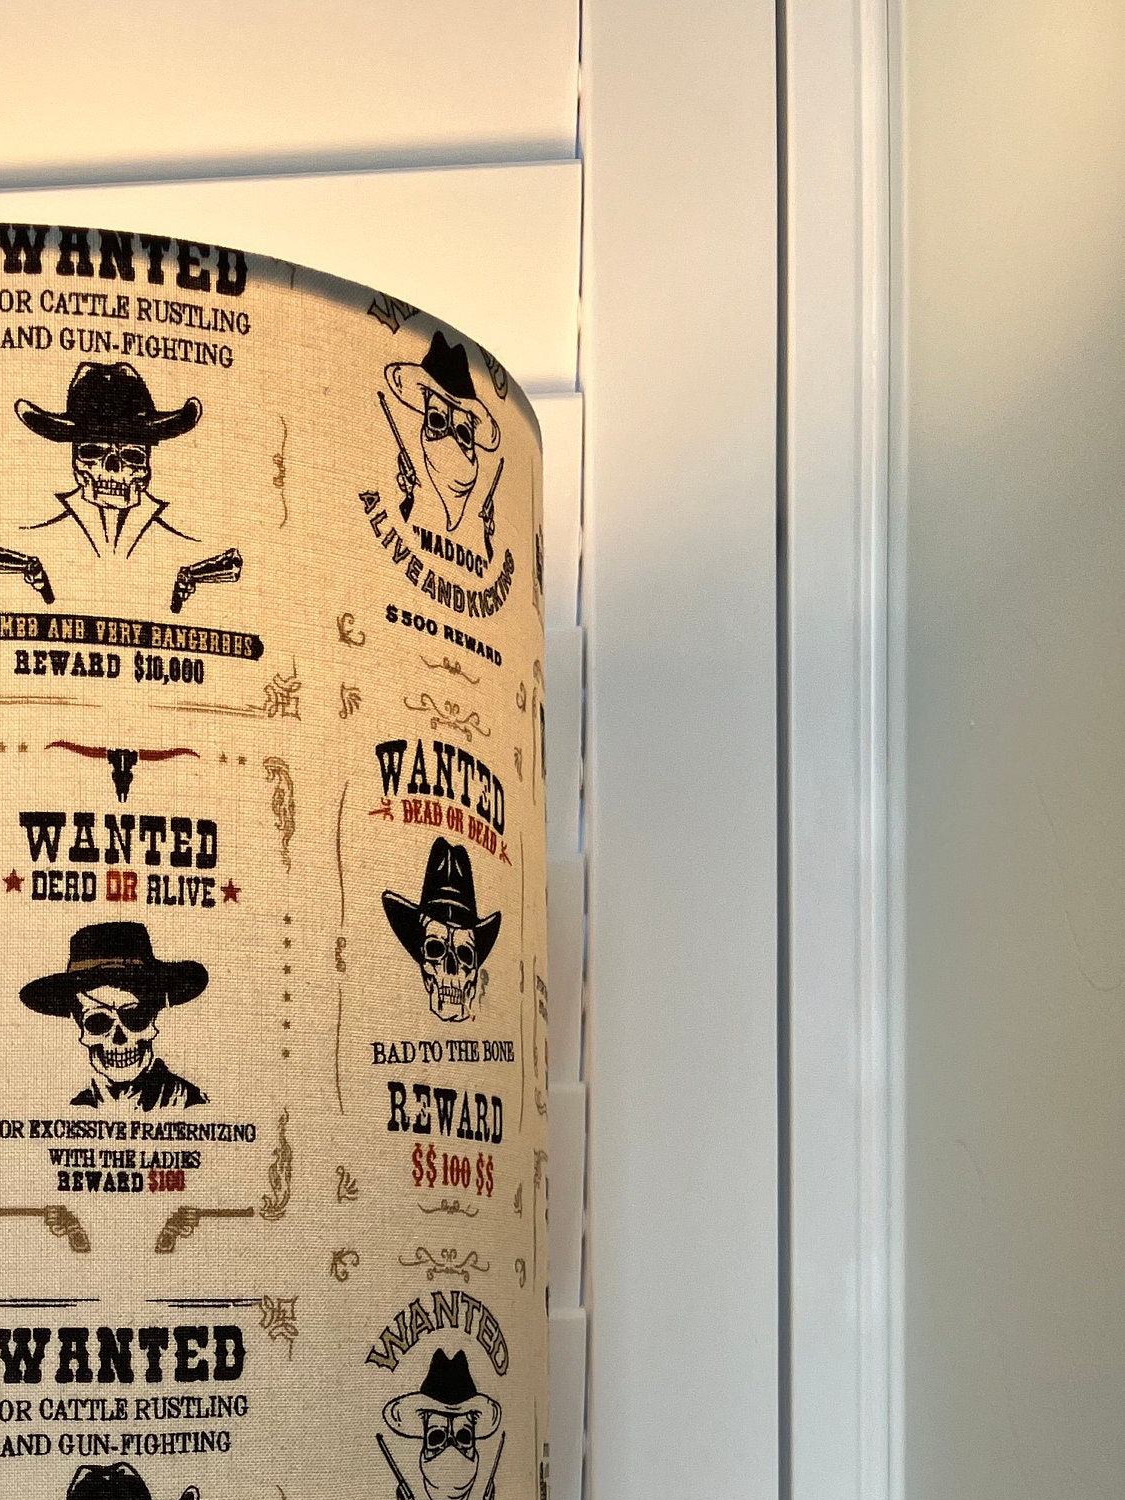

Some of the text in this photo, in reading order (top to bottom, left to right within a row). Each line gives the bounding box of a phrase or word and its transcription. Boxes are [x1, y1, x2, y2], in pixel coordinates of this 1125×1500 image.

[40, 290, 130, 319] CATTLE
[137, 297, 251, 335] RUSTLING
[0, 325, 234, 369] AND GUN-FIGHTING
[443, 625, 502, 666] REWARD
[13, 650, 204, 684] REWARD $10,000
[375, 738, 506, 836] WANTED
[18, 811, 219, 870] WANTED
[402, 799, 498, 857] DEAD OR DEAD
[31, 870, 216, 909] DEAD OR ALIVE
[371, 1040, 516, 1066] BAD TO THE BONE
[28, 1120, 128, 1142] EXCESSIVE
[130, 1120, 257, 1144] FRATERNIZING
[386, 1080, 503, 1145] REWARD
[48, 1149, 202, 1169] WITH THE LADIES
[57, 1170, 144, 1193] REWARD
[365, 1290, 510, 1376] WANTED
[39, 1398, 129, 1422] CATTLE
[134, 1394, 250, 1421] RUSTLING
[0, 1431, 233, 1459] AND GUN-FIGHTING
